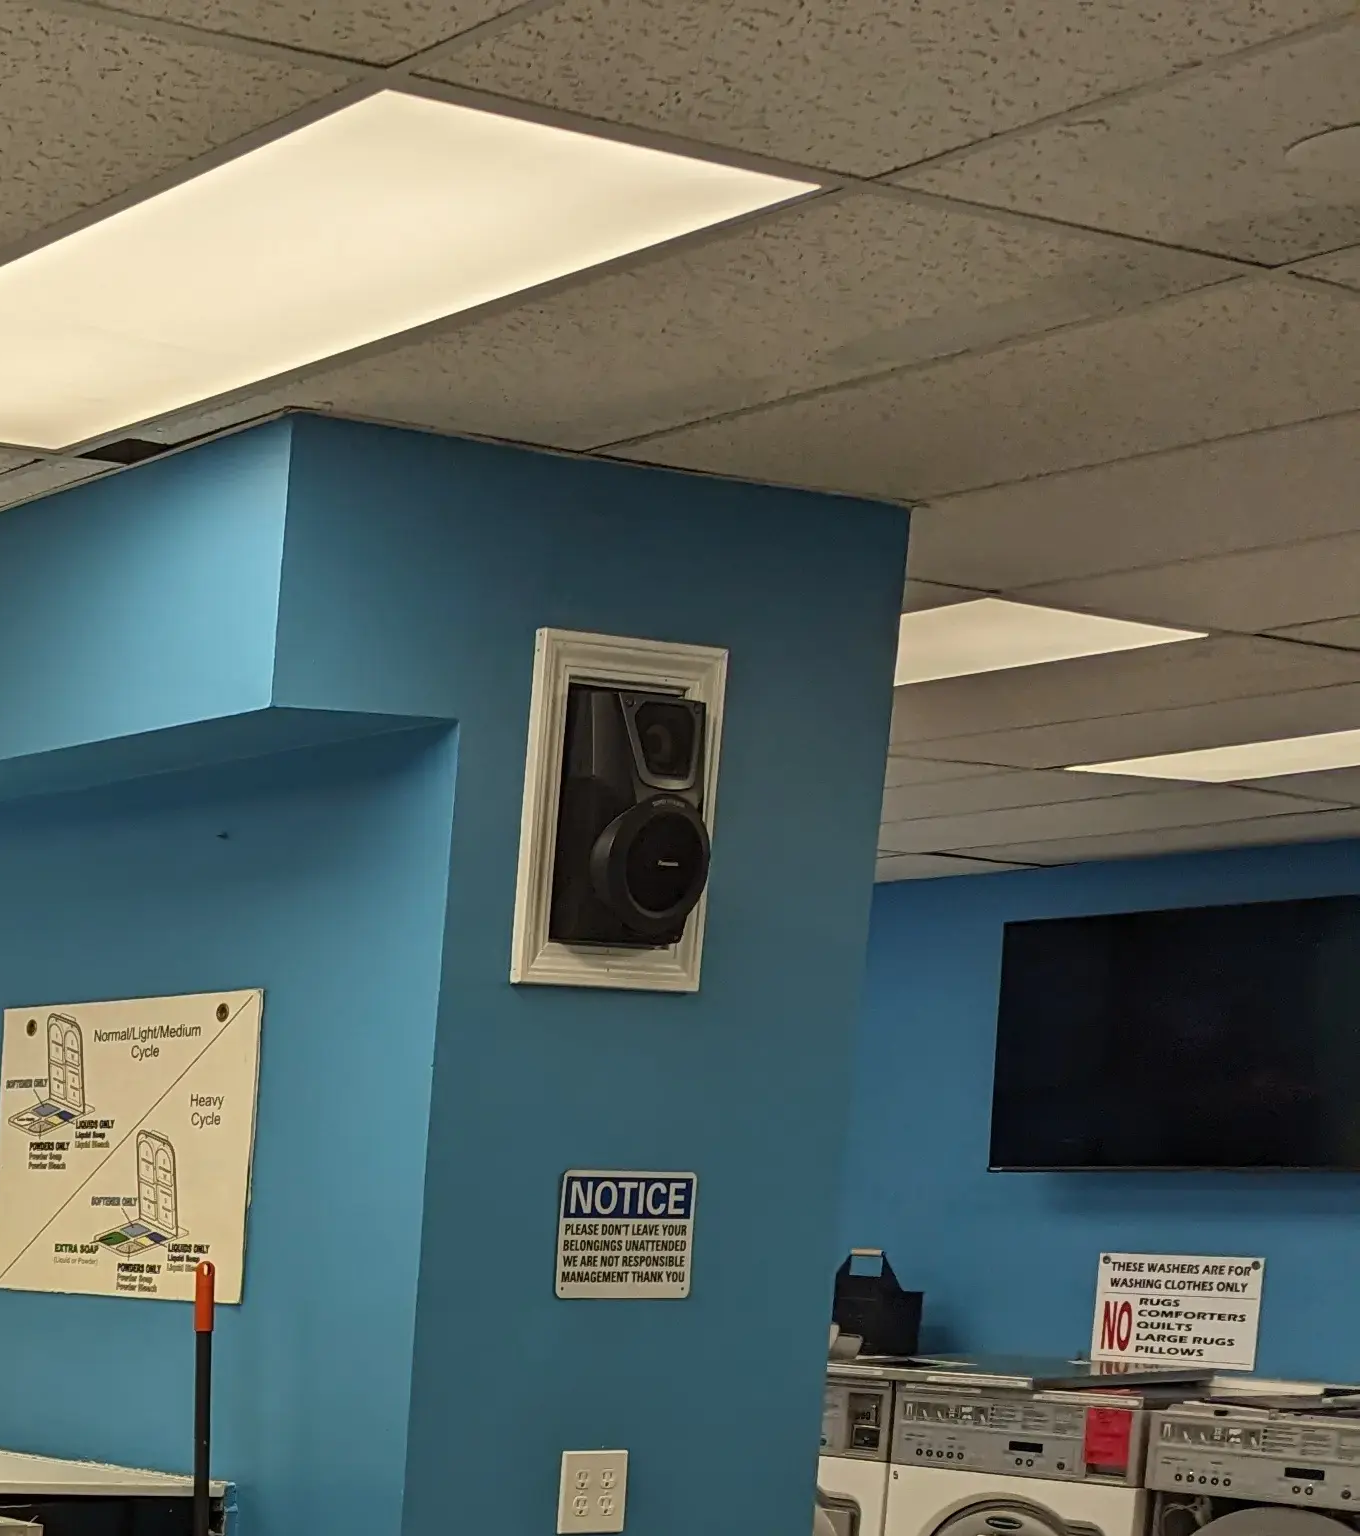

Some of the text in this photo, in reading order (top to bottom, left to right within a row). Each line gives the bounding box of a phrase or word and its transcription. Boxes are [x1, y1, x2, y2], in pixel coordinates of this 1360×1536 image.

[93, 1024, 202, 1042] Normal/Light/Medium
[130, 1045, 159, 1059] Cycle
[190, 1093, 224, 1109] Heavy
[191, 1111, 221, 1127] Cycle
[570, 1181, 686, 1215] NOTICE
[564, 1223, 687, 1236] PLEASE DON'T LEAVE YOUR
[54, 1243, 99, 1254] EXTRA SOAP
[563, 1239, 687, 1252] BELONGINGS UNATTENDED
[563, 1256, 685, 1268] WE ARE NOT RESPONSIBLE
[1111, 1261, 1252, 1277] THESE WASHERS ARE FOR
[561, 1271, 685, 1283] MANAGEMENT THANK YOU
[1110, 1278, 1248, 1293] WASHING CLOTHES ONLY
[1139, 1297, 1180, 1307] RUGS
[1137, 1309, 1246, 1322] COMFORTERS
[1100, 1300, 1133, 1352] NO
[1136, 1321, 1192, 1332] QUILTS
[1135, 1333, 1235, 1347] LARGE RUGS
[1134, 1345, 1204, 1357] PILLOWS
